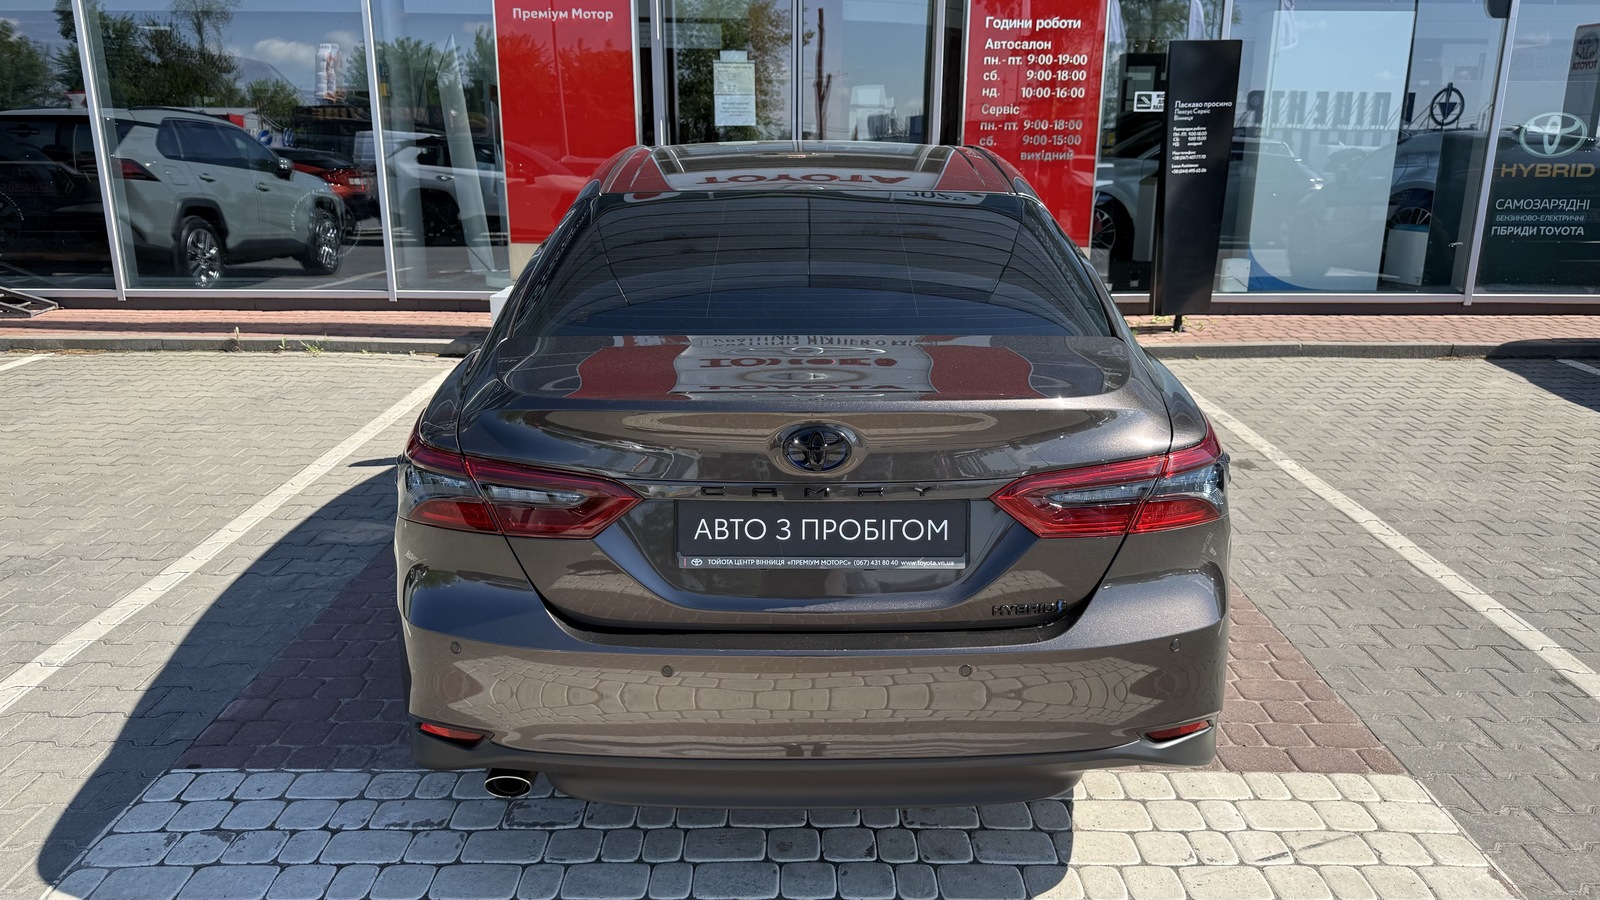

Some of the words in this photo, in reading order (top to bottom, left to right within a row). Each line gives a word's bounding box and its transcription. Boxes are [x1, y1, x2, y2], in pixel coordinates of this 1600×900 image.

[512, 8, 568, 21] Преміум
[571, 8, 614, 22] Мотор
[985, 16, 1032, 30] Години
[1035, 17, 1081, 31] роботи
[984, 38, 1052, 50] Автосалон
[1027, 54, 1088, 65] 9:00-19:00
[983, 70, 1000, 81] сб.
[1026, 70, 1087, 81] 9:00-18:00
[982, 87, 1000, 98] нд.
[1021, 87, 1085, 98] 10:00-16:00
[981, 104, 1020, 116] Сервіс
[1175, 100, 1203, 108] Ласкаво
[1023, 119, 1083, 130] 9:00-18:00
[979, 135, 997, 146] сб.
[1022, 134, 1082, 145] 9:00-15:00
[1020, 149, 1074, 161] вихідний
[1500, 163, 1596, 178] HYBRID
[1495, 198, 1591, 212] САМОЗАРЯДНІ
[1496, 214, 1585, 222] БЕНЗИНОВО-ЕЛЕКТРИЧНІ
[1491, 225, 1537, 236] ГІБРИДИ
[1539, 226, 1585, 236] TOYOTA
[700, 485, 939, 497] CAMRY
[693, 518, 767, 540] АВТО
[801, 518, 949, 541] ПРОБІГОМ
[707, 558, 733, 566] ТОЙОТА
[853, 559, 870, 567] (067)
[900, 558, 955, 567] www.toyota.vn.ua
[991, 603, 1055, 617] HYBRID
